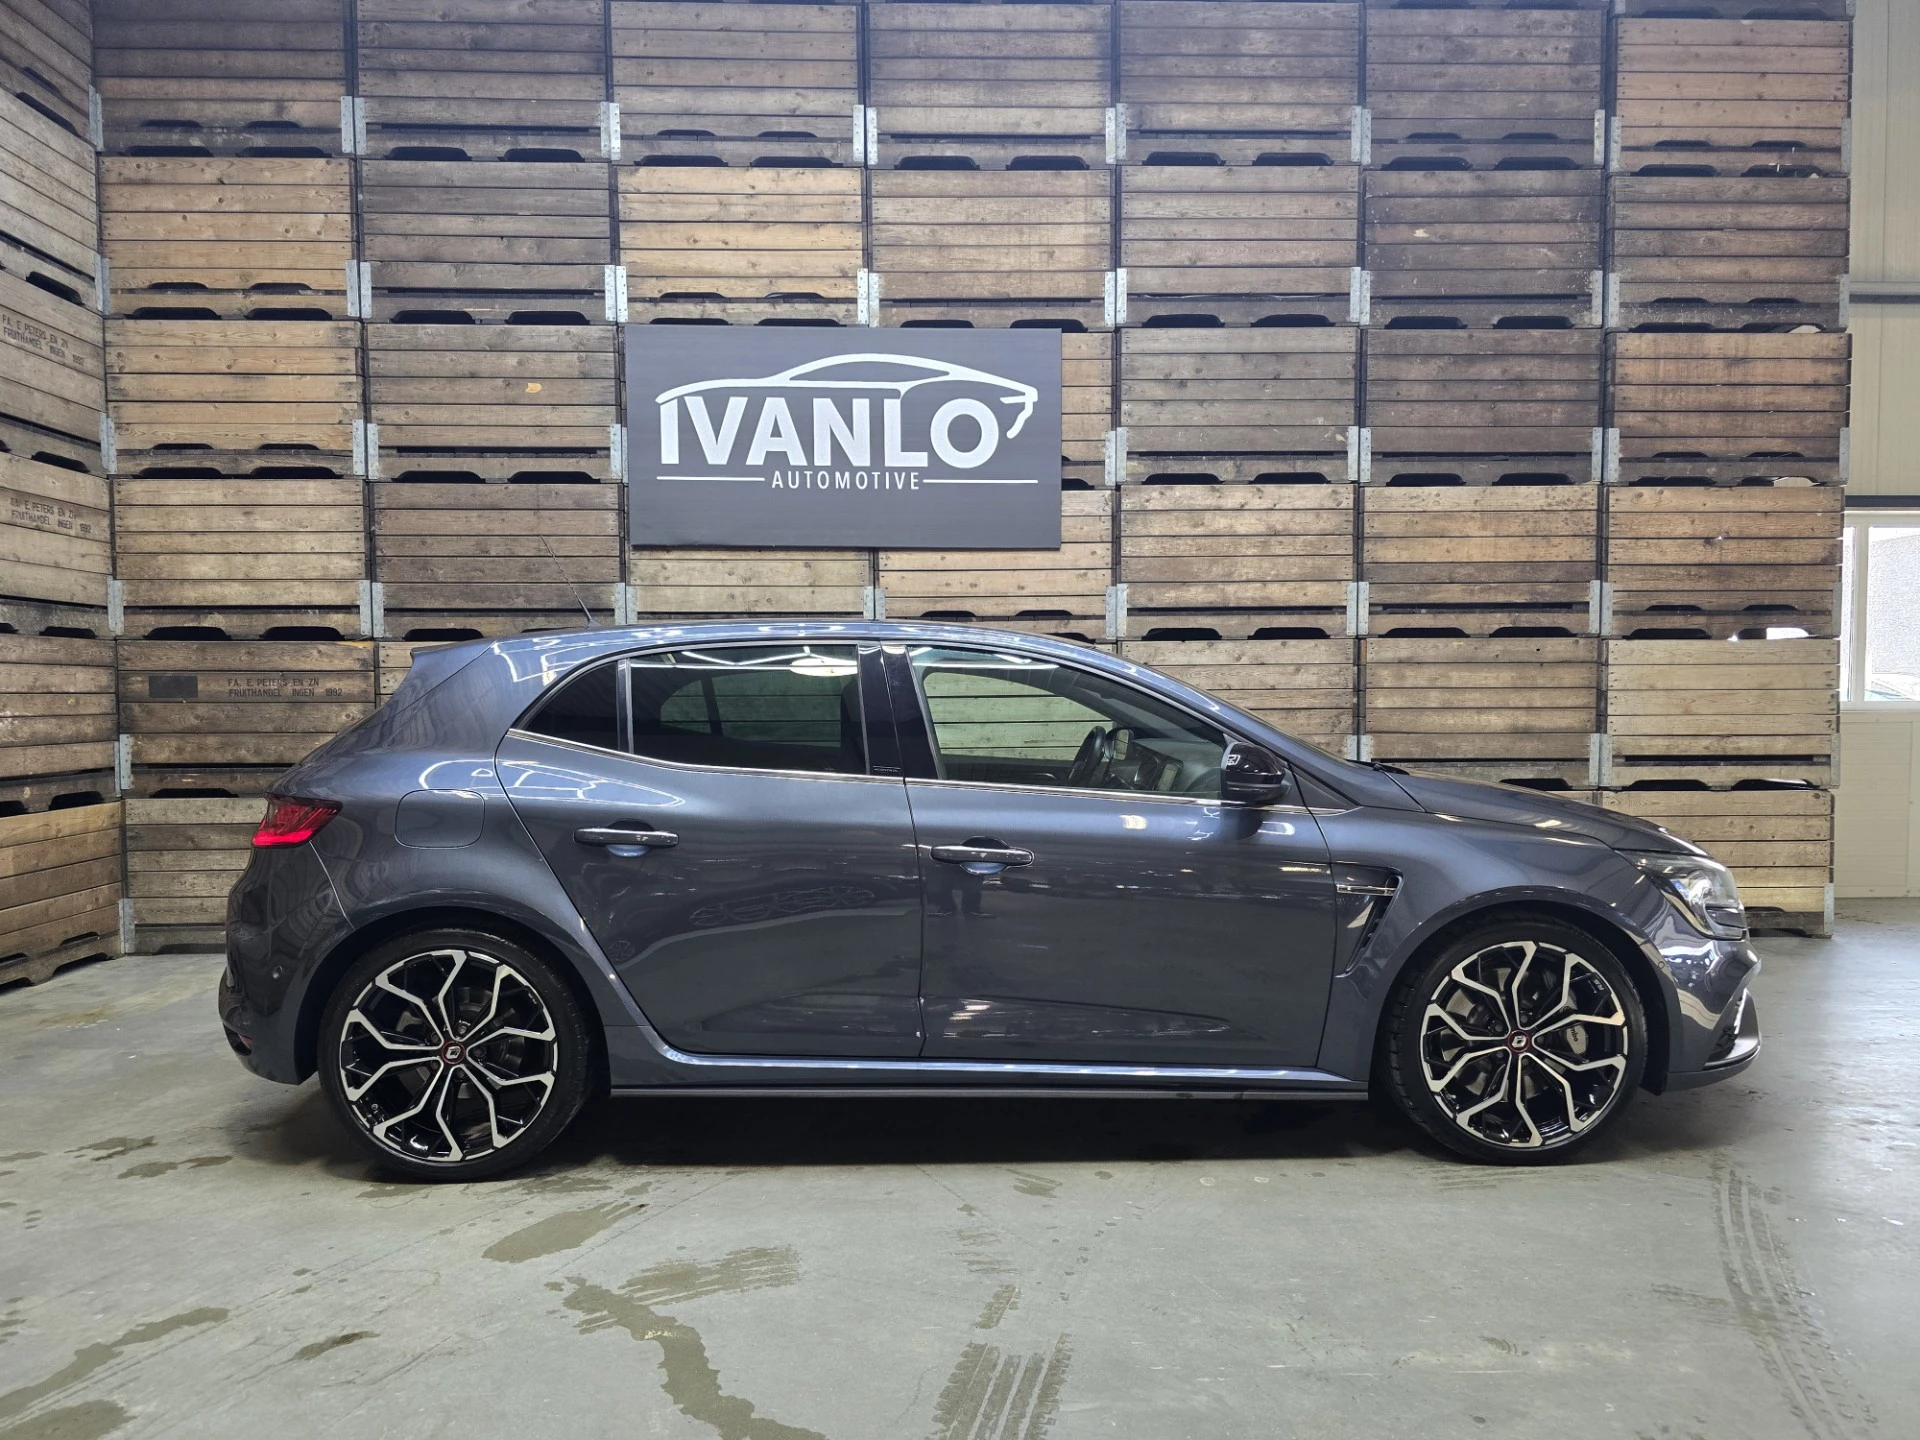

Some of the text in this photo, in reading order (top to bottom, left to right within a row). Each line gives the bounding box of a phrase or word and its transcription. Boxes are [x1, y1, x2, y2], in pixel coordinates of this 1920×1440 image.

[659, 396, 1000, 469] IVANLO
[771, 470, 920, 491] AUTOMOTIVE
[325, 687, 343, 697] 1992
